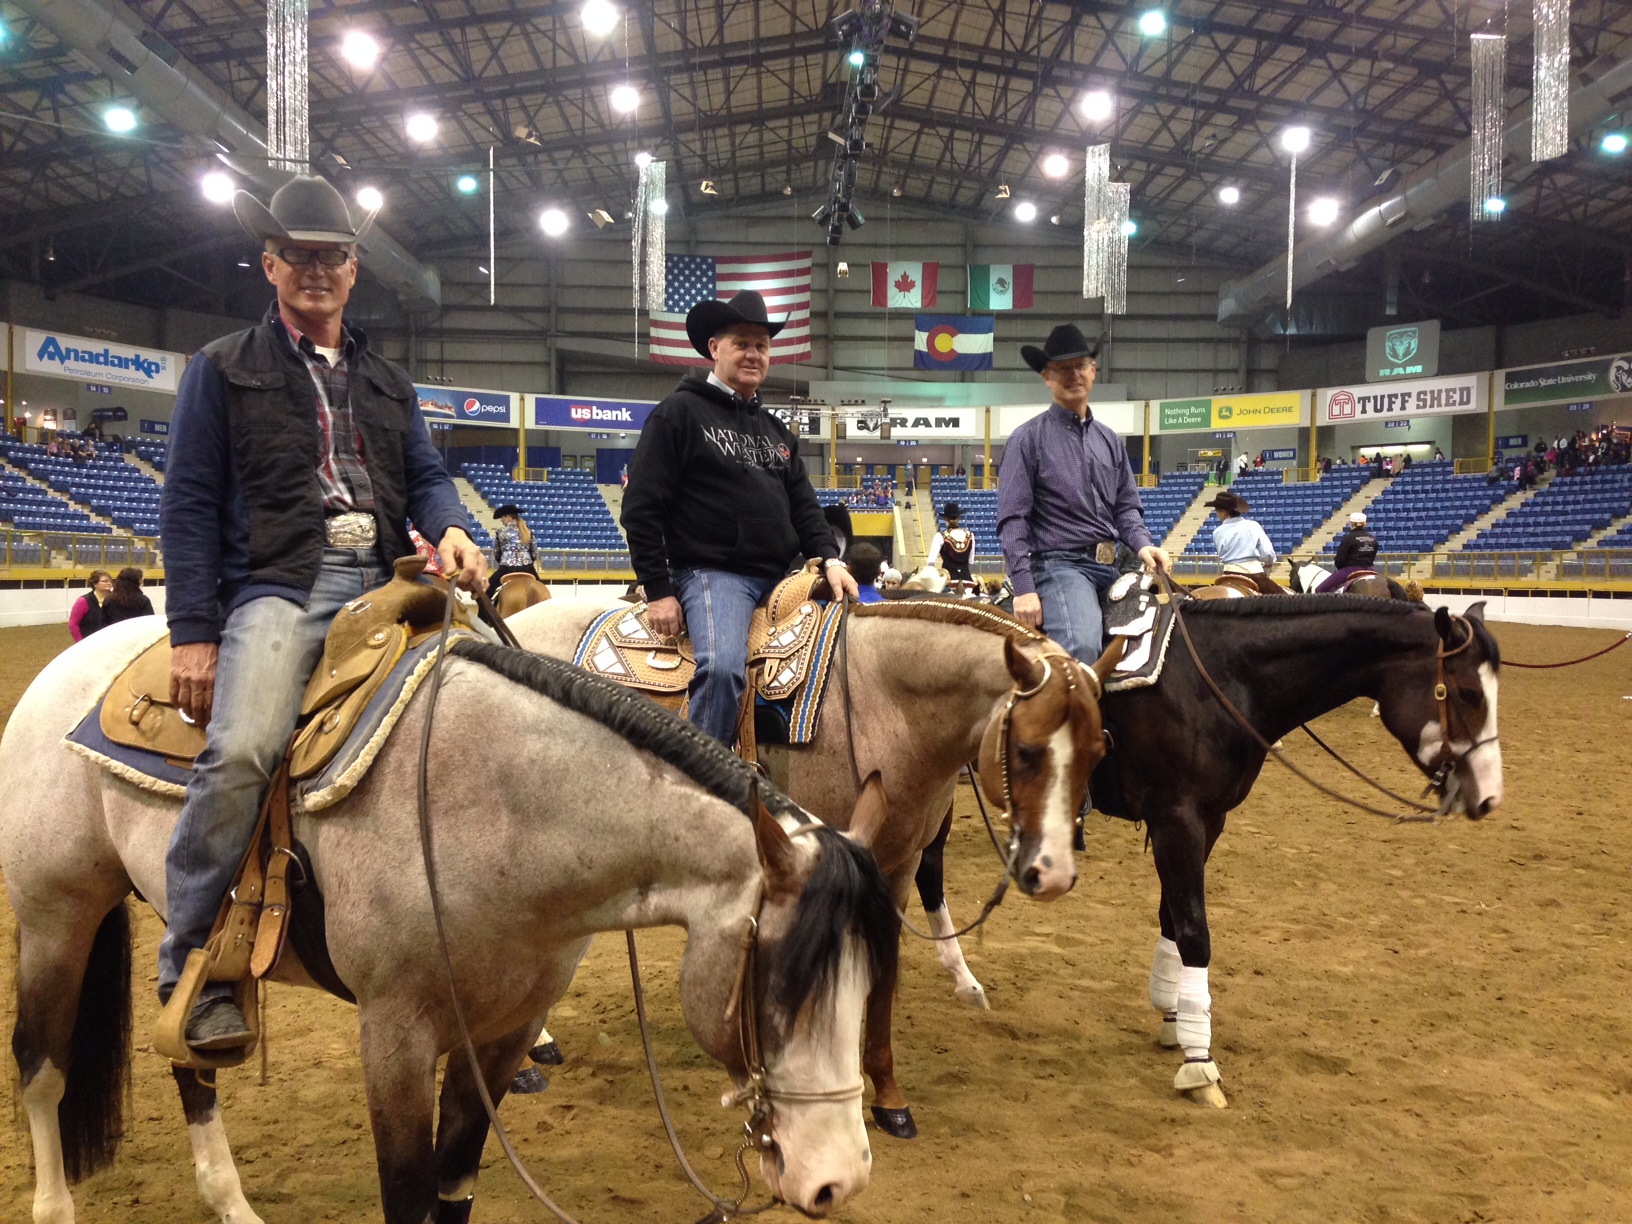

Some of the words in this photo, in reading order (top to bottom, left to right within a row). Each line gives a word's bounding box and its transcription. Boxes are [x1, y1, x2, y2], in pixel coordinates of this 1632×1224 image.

[37, 336, 160, 379] Anadarko
[64, 366, 103, 379] Petroleum
[105, 372, 149, 385] Corporation
[1379, 365, 1422, 376] RAM
[1505, 380, 1538, 390] Colorado
[1539, 378, 1557, 387] State
[1557, 371, 1597, 383] University
[1357, 392, 1412, 414] TUFF
[1416, 386, 1471, 410] SHED
[481, 405, 506, 414] pepsi
[1165, 407, 1190, 415] Nothing
[1236, 408, 1262, 416] JOHN
[1263, 406, 1294, 414] DEERE
[889, 417, 960, 428] RAM
[1183, 416, 1201, 424] Deere
[1273, 450, 1294, 458] WOMEN
